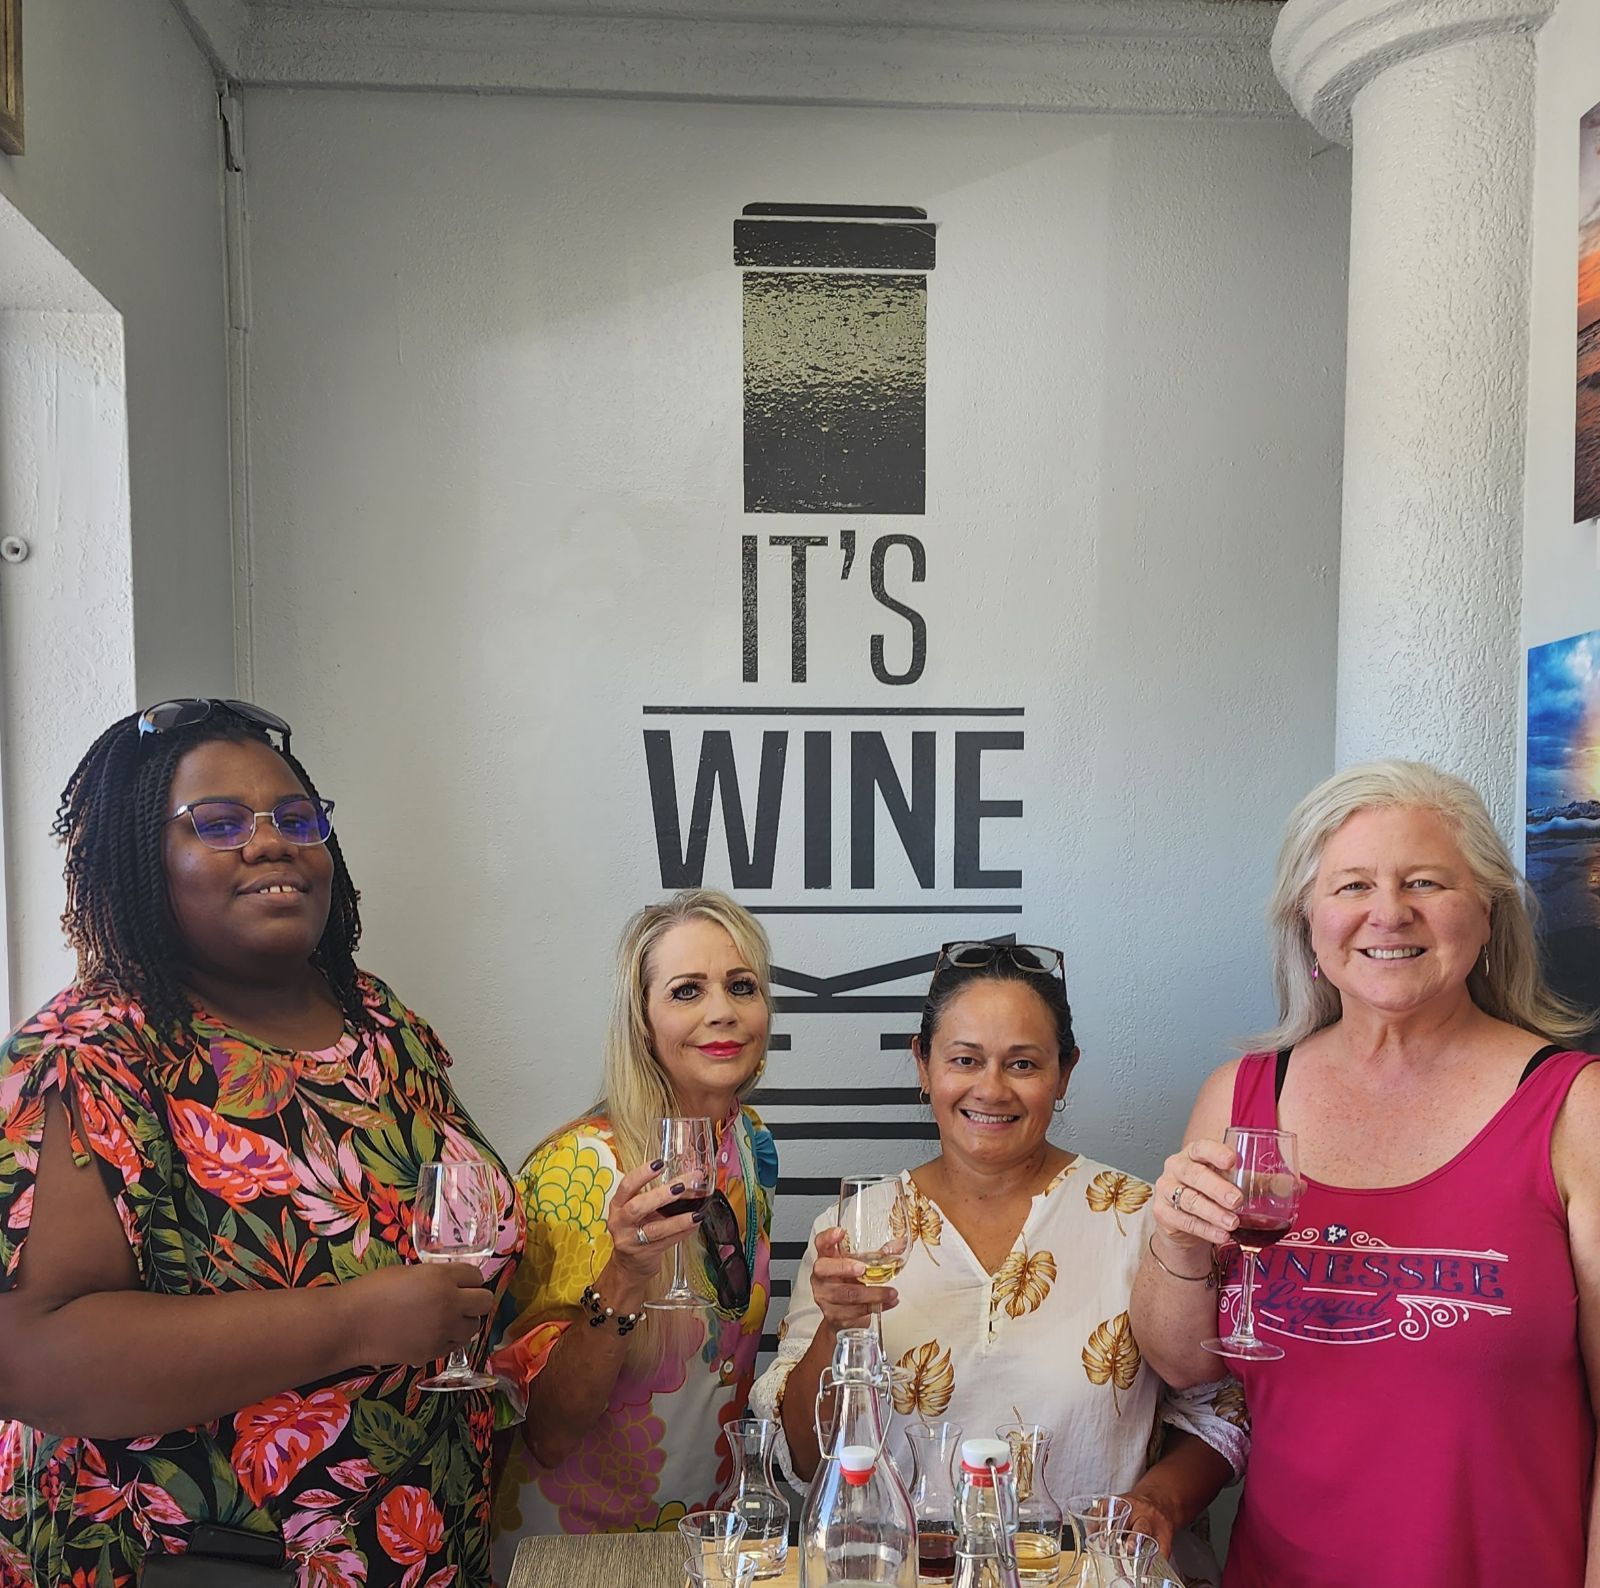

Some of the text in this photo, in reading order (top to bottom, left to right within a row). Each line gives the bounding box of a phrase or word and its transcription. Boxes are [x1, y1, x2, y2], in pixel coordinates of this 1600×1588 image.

[742, 530, 927, 686] IT'S
[643, 730, 1025, 890] WINE
[1220, 1246, 1504, 1299] ENNESSEE
[1254, 1280, 1393, 1325] Legend
